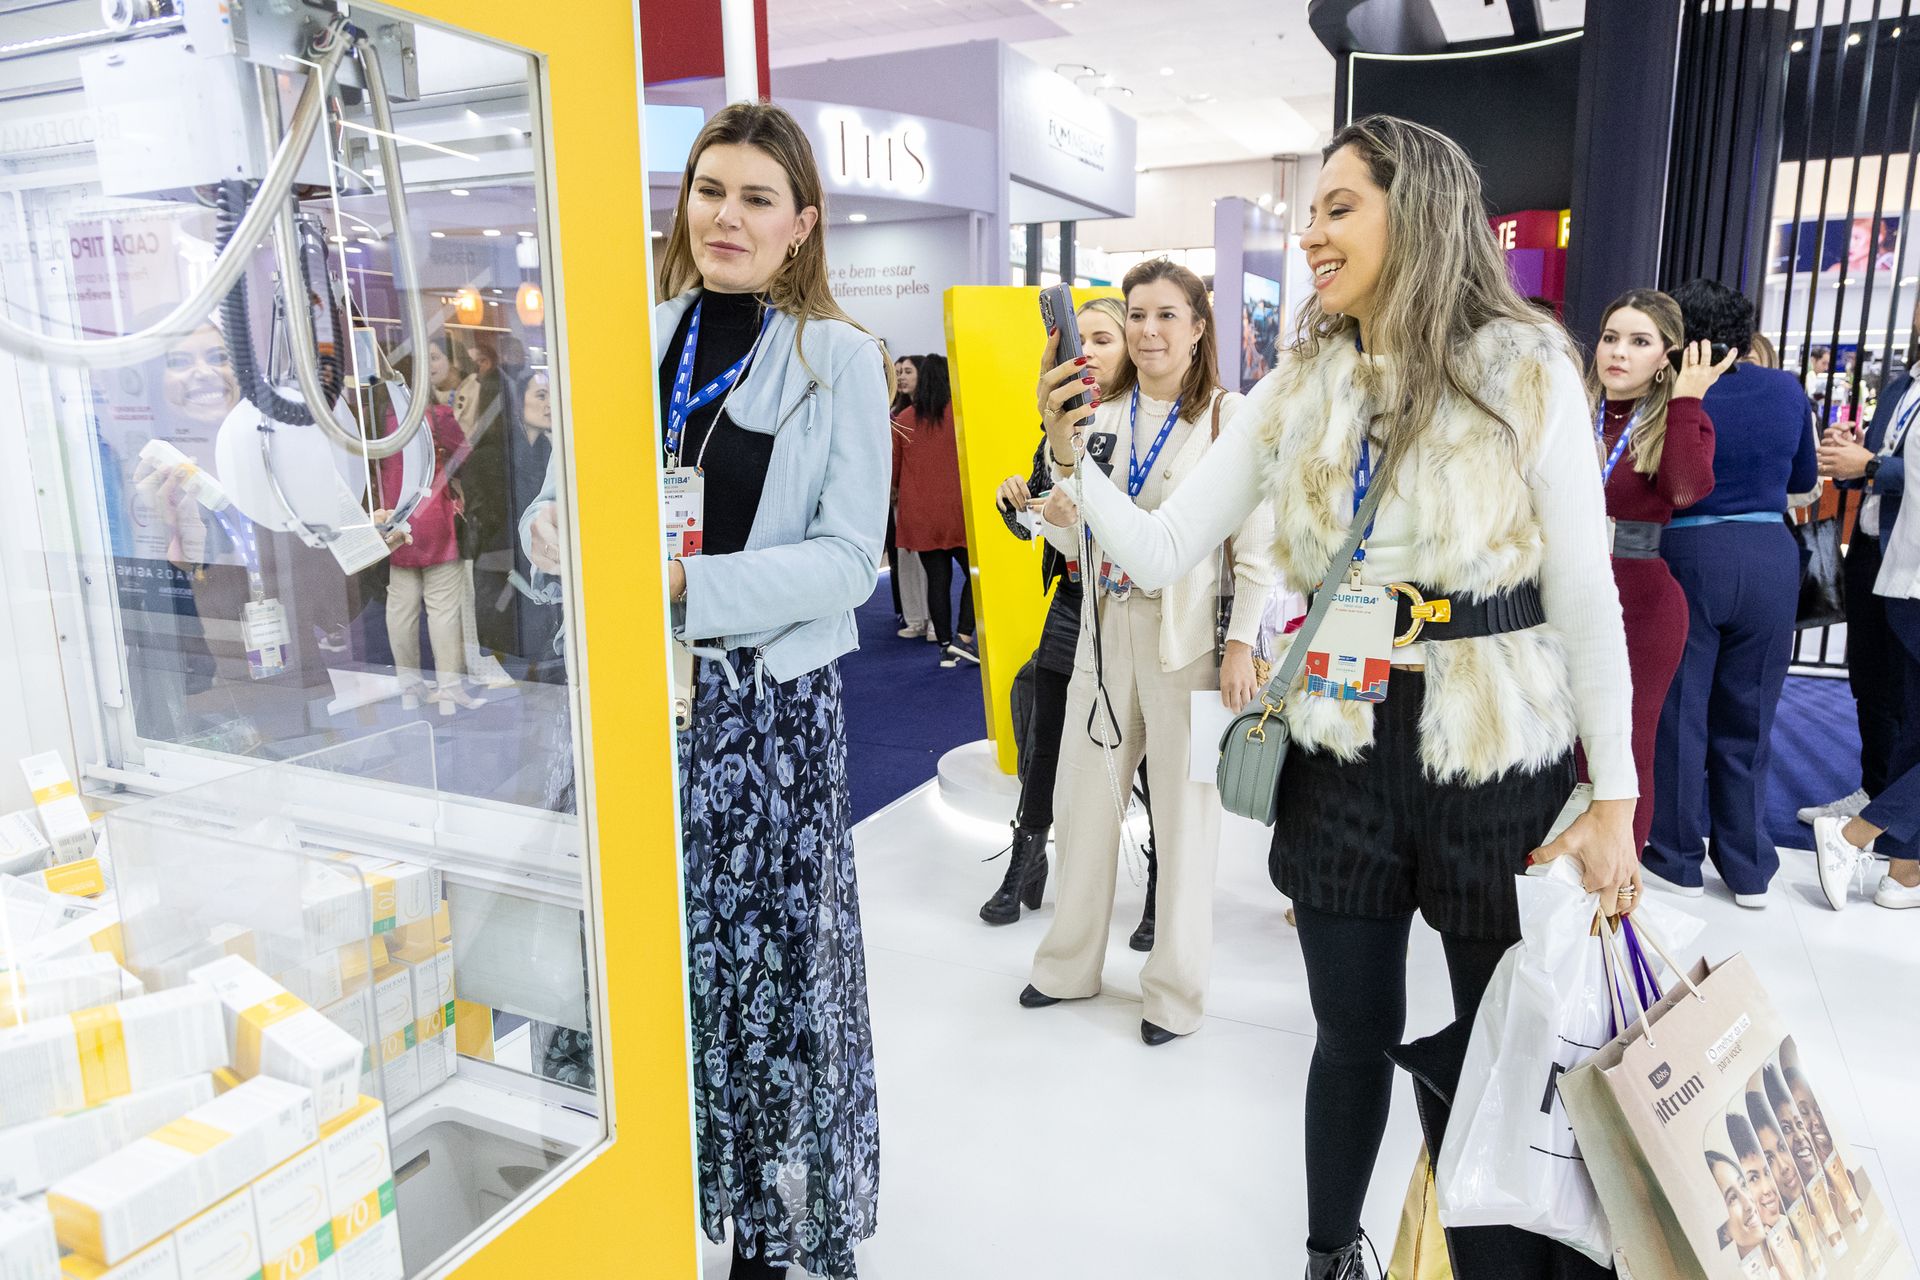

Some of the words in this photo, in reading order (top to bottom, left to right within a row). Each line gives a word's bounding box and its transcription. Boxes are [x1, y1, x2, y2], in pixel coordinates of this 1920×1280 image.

[838, 269, 846, 279] e
[849, 263, 916, 279] bem-estar
[896, 279, 930, 299] peles
[423, 1011, 442, 1035] 70
[1708, 1048, 1718, 1060] O
[1717, 1056, 1732, 1074] para
[1652, 1069, 1669, 1084] Libbs
[328, 1116, 381, 1151] BIODERMA
[342, 1198, 369, 1238] 70
